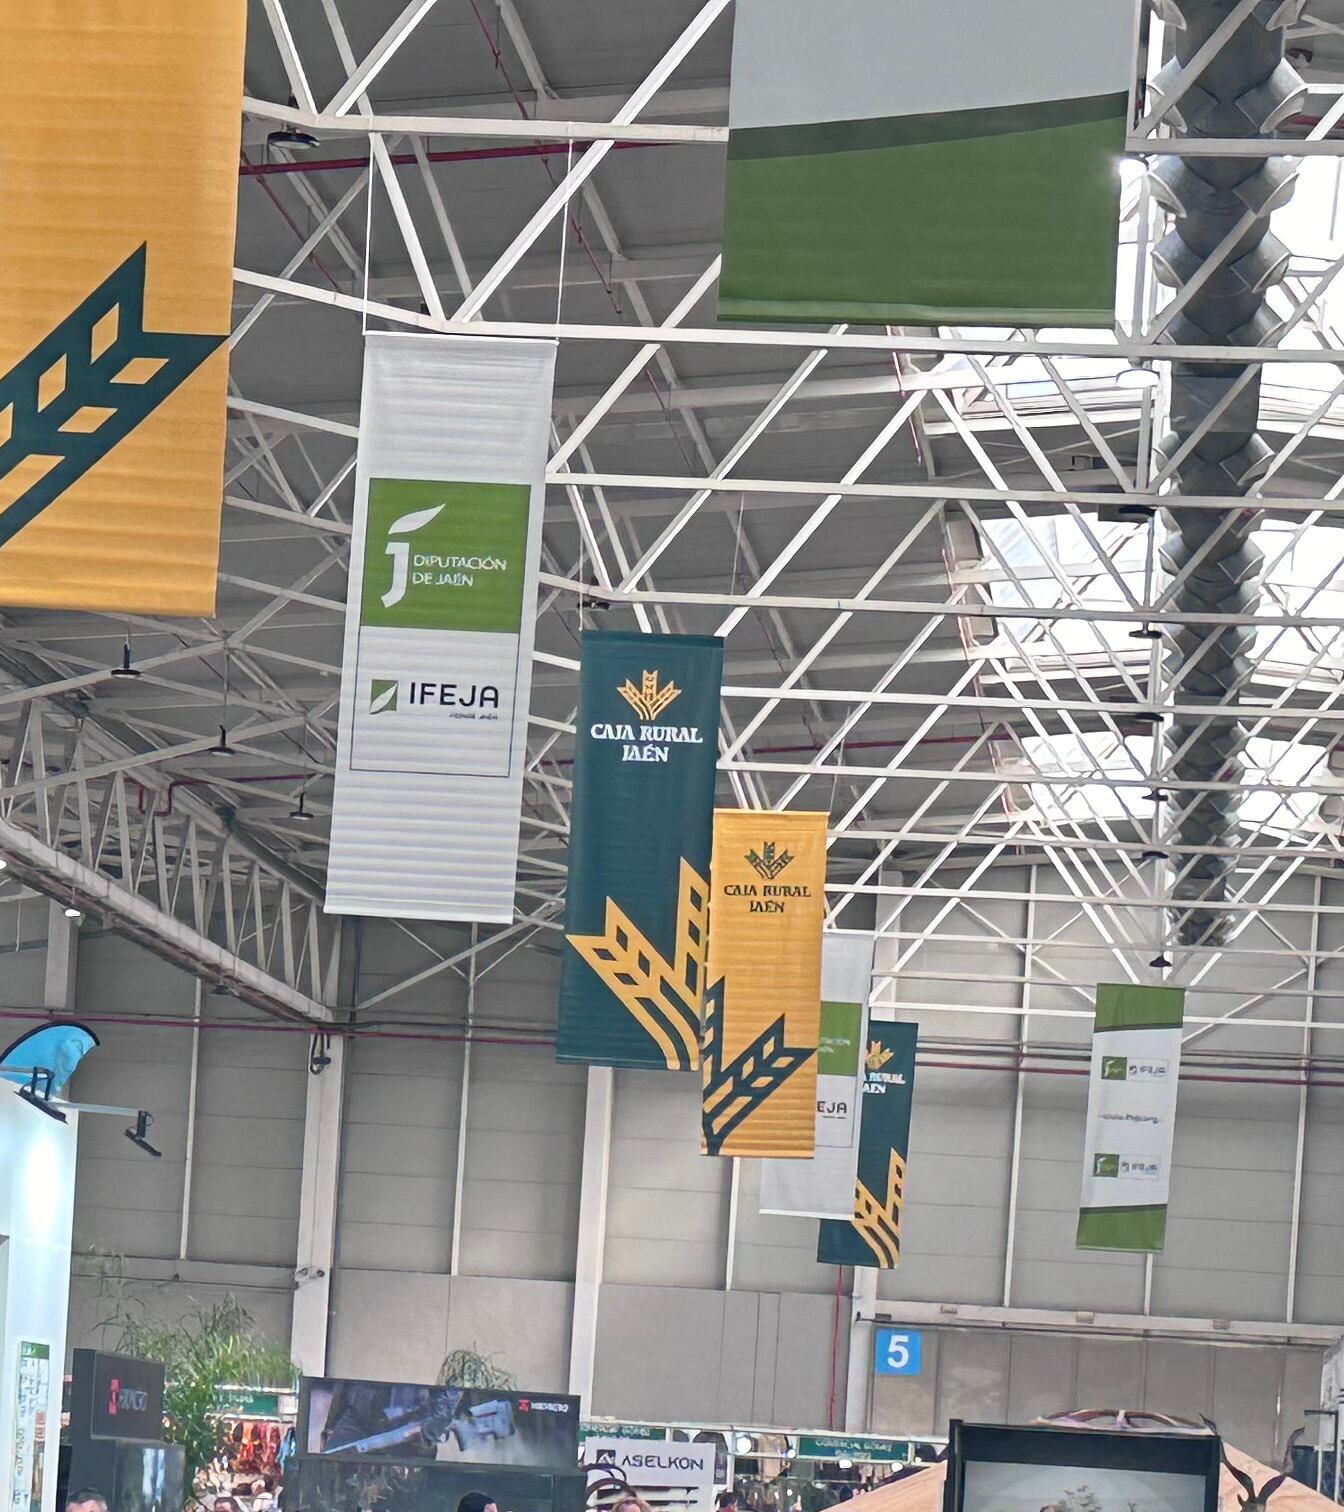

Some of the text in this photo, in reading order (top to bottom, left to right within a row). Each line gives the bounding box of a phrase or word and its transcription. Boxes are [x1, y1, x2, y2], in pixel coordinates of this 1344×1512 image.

[412, 572, 433, 585] DE
[409, 682, 499, 709] IFEJA
[591, 723, 703, 743] CAJA RURAL
[621, 743, 669, 762] JAÉN
[817, 1101, 847, 1113] EJA
[887, 1334, 910, 1369] 5
[621, 1454, 704, 1471] ASELKON
